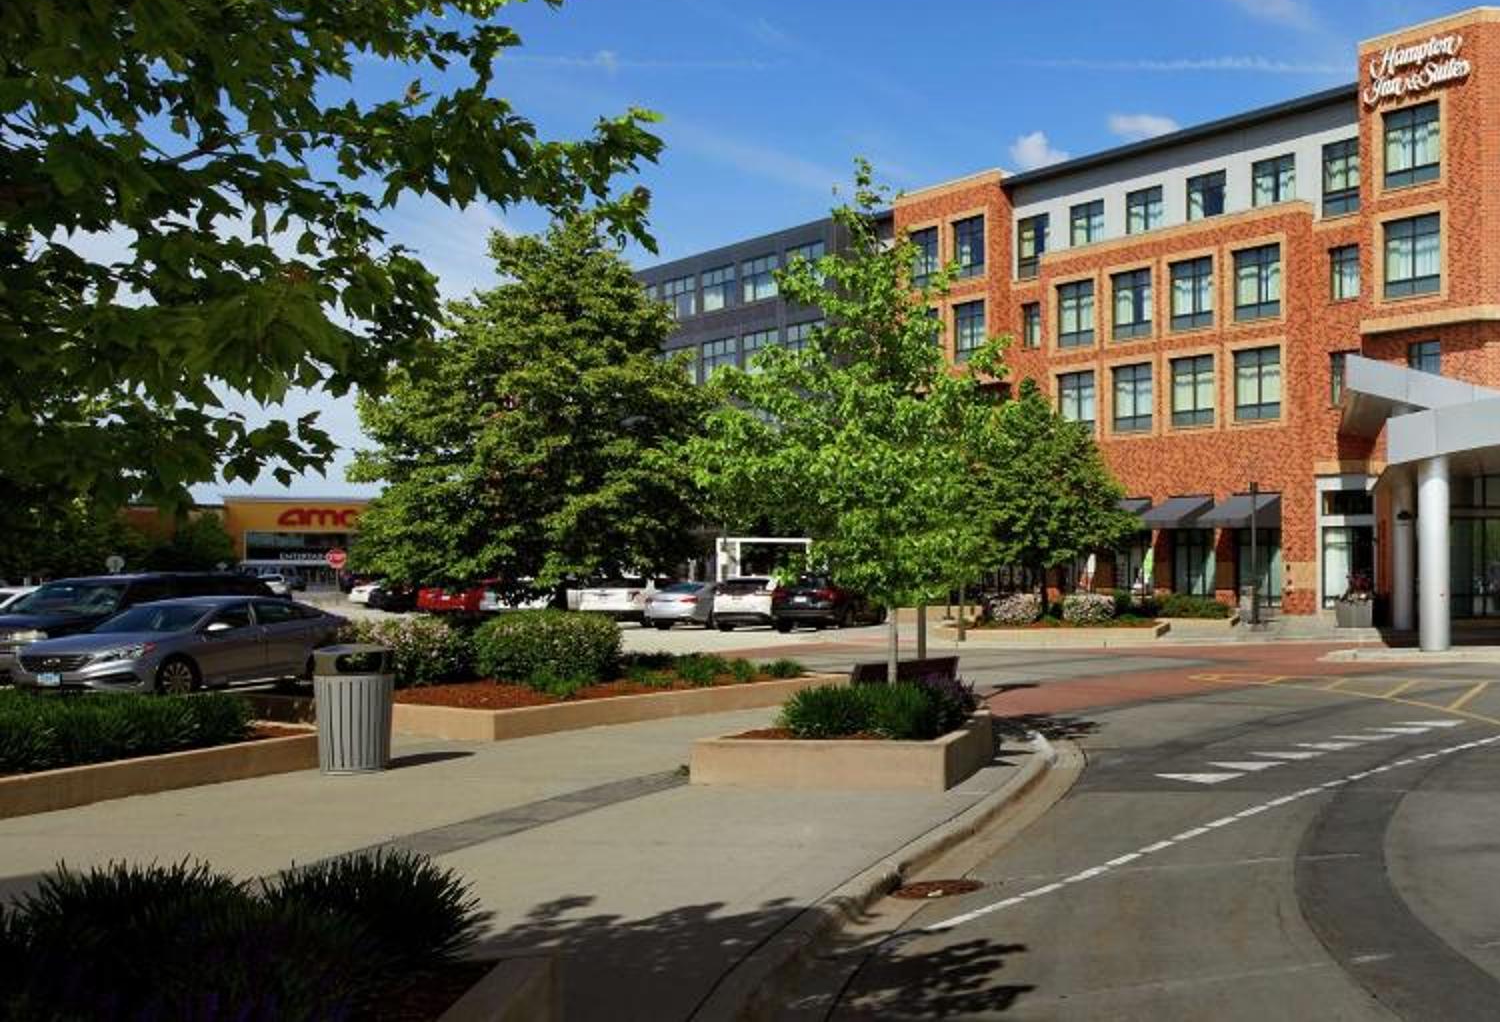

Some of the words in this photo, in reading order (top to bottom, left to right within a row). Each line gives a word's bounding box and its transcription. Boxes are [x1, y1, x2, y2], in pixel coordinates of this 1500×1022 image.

[1369, 34, 1463, 79] Hampton
[1363, 77, 1407, 105] Inn
[1420, 58, 1471, 87] Suites
